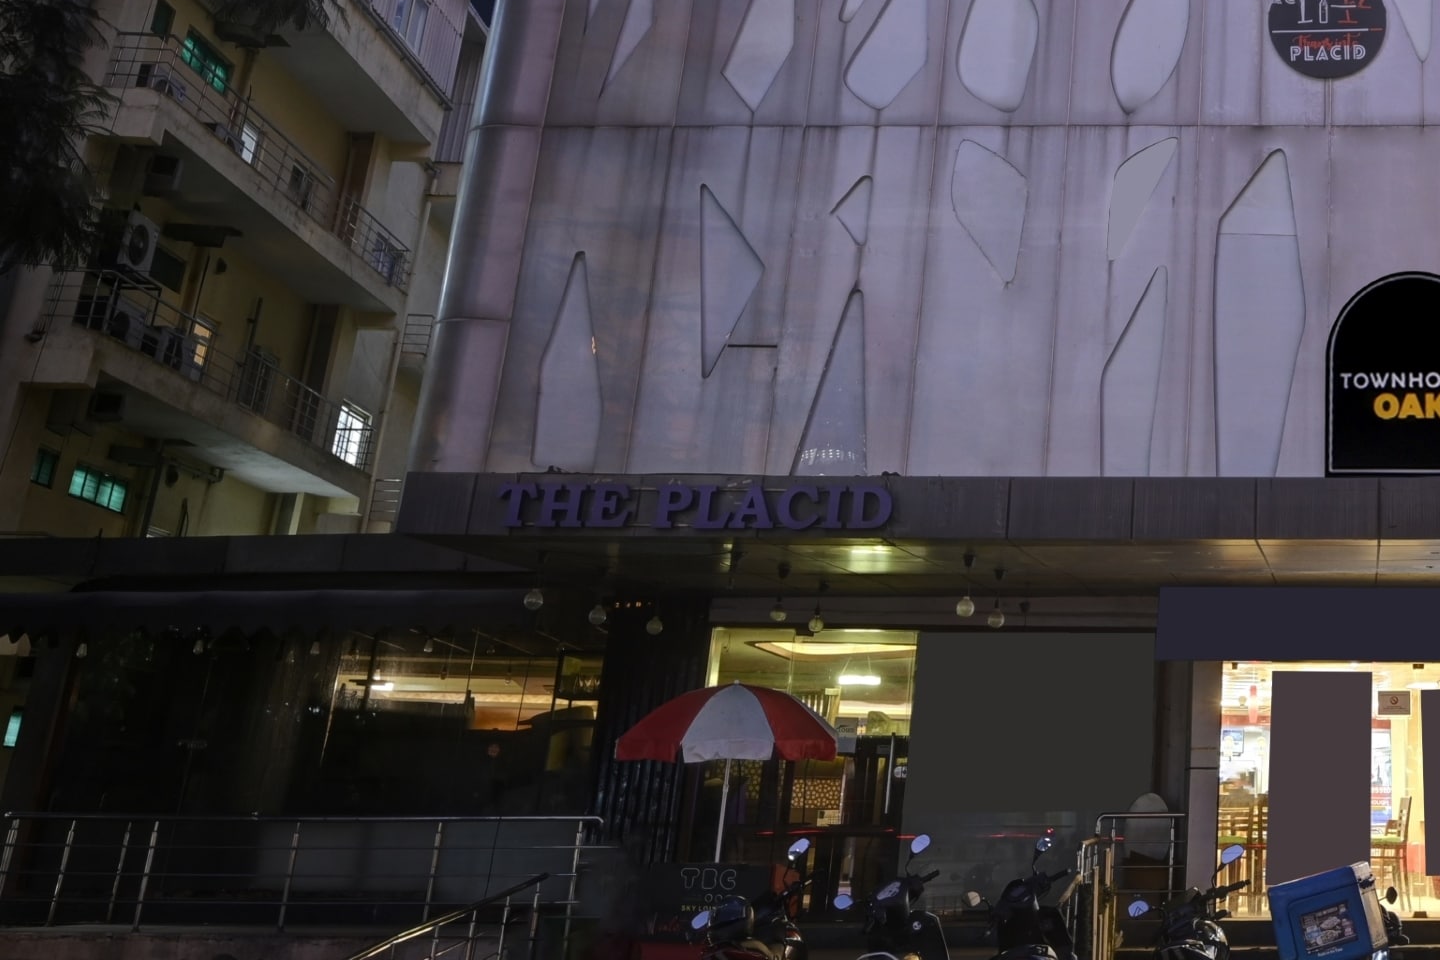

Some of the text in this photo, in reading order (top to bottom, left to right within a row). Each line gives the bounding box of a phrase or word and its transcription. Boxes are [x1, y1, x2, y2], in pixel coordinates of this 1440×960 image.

[1290, 44, 1366, 61] PLACID
[500, 481, 893, 529] THE PLACID
